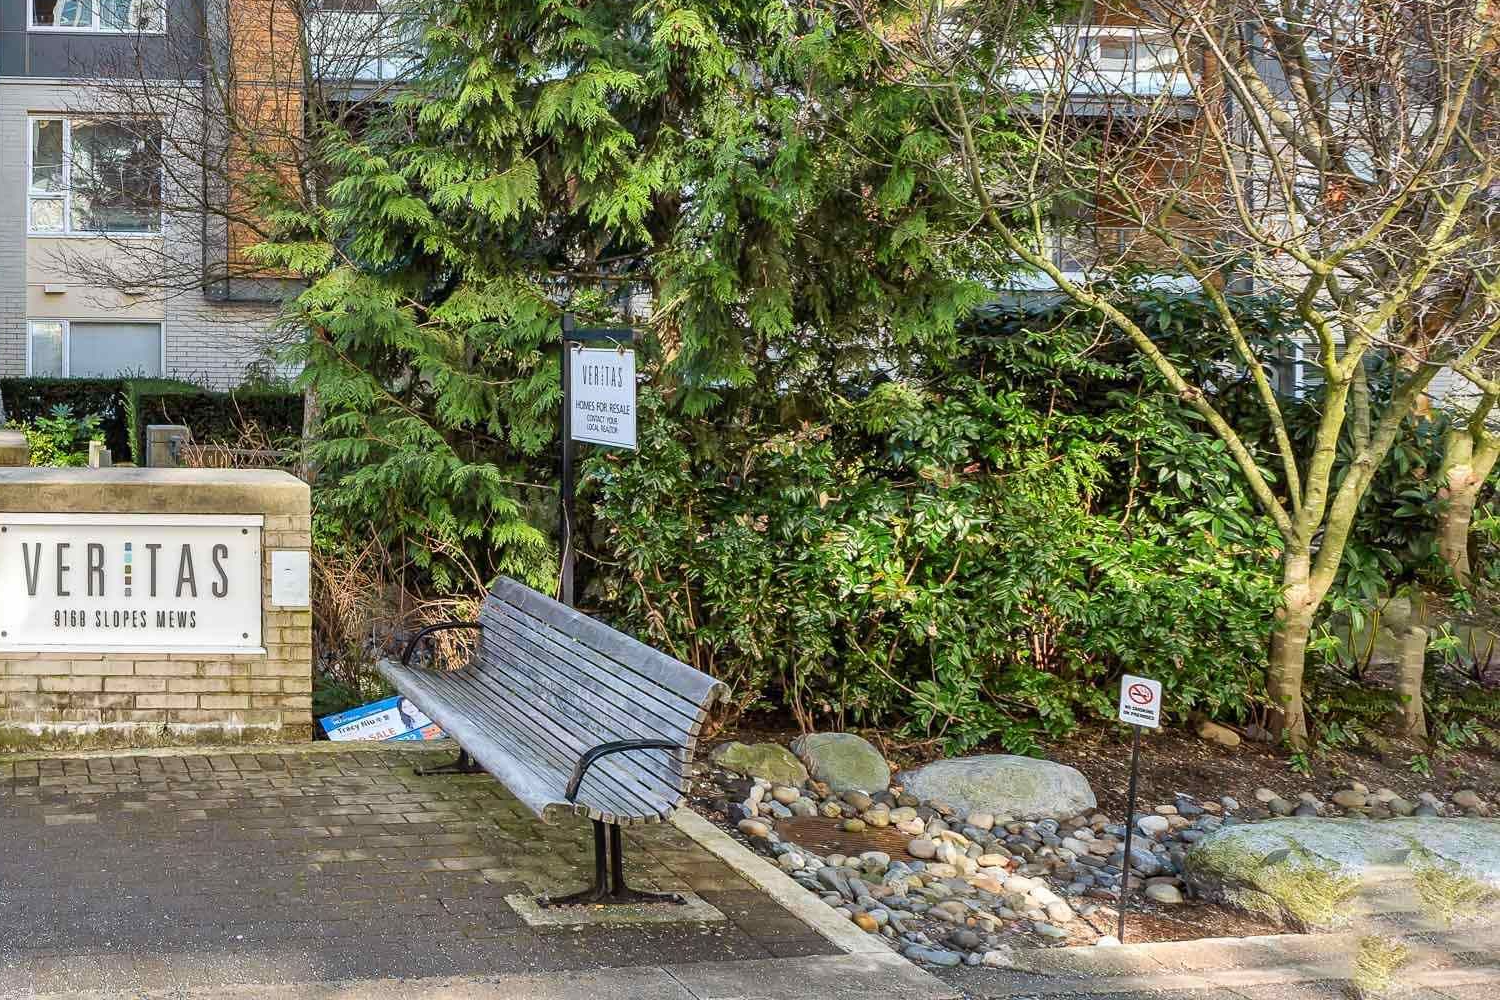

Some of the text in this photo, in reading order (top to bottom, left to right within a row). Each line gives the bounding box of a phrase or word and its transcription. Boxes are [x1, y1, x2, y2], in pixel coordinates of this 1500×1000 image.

[582, 365, 623, 388] VERITAS
[575, 400, 631, 415] HOMES FOR RESALE
[586, 414, 619, 425] CONTACT YOUR
[586, 423, 600, 432] LOCAL
[21, 541, 229, 599] VERITAS
[54, 610, 197, 628] 9168 SLOPES MEWS
[337, 723, 360, 734] Tracy
[369, 727, 397, 741] SALE
